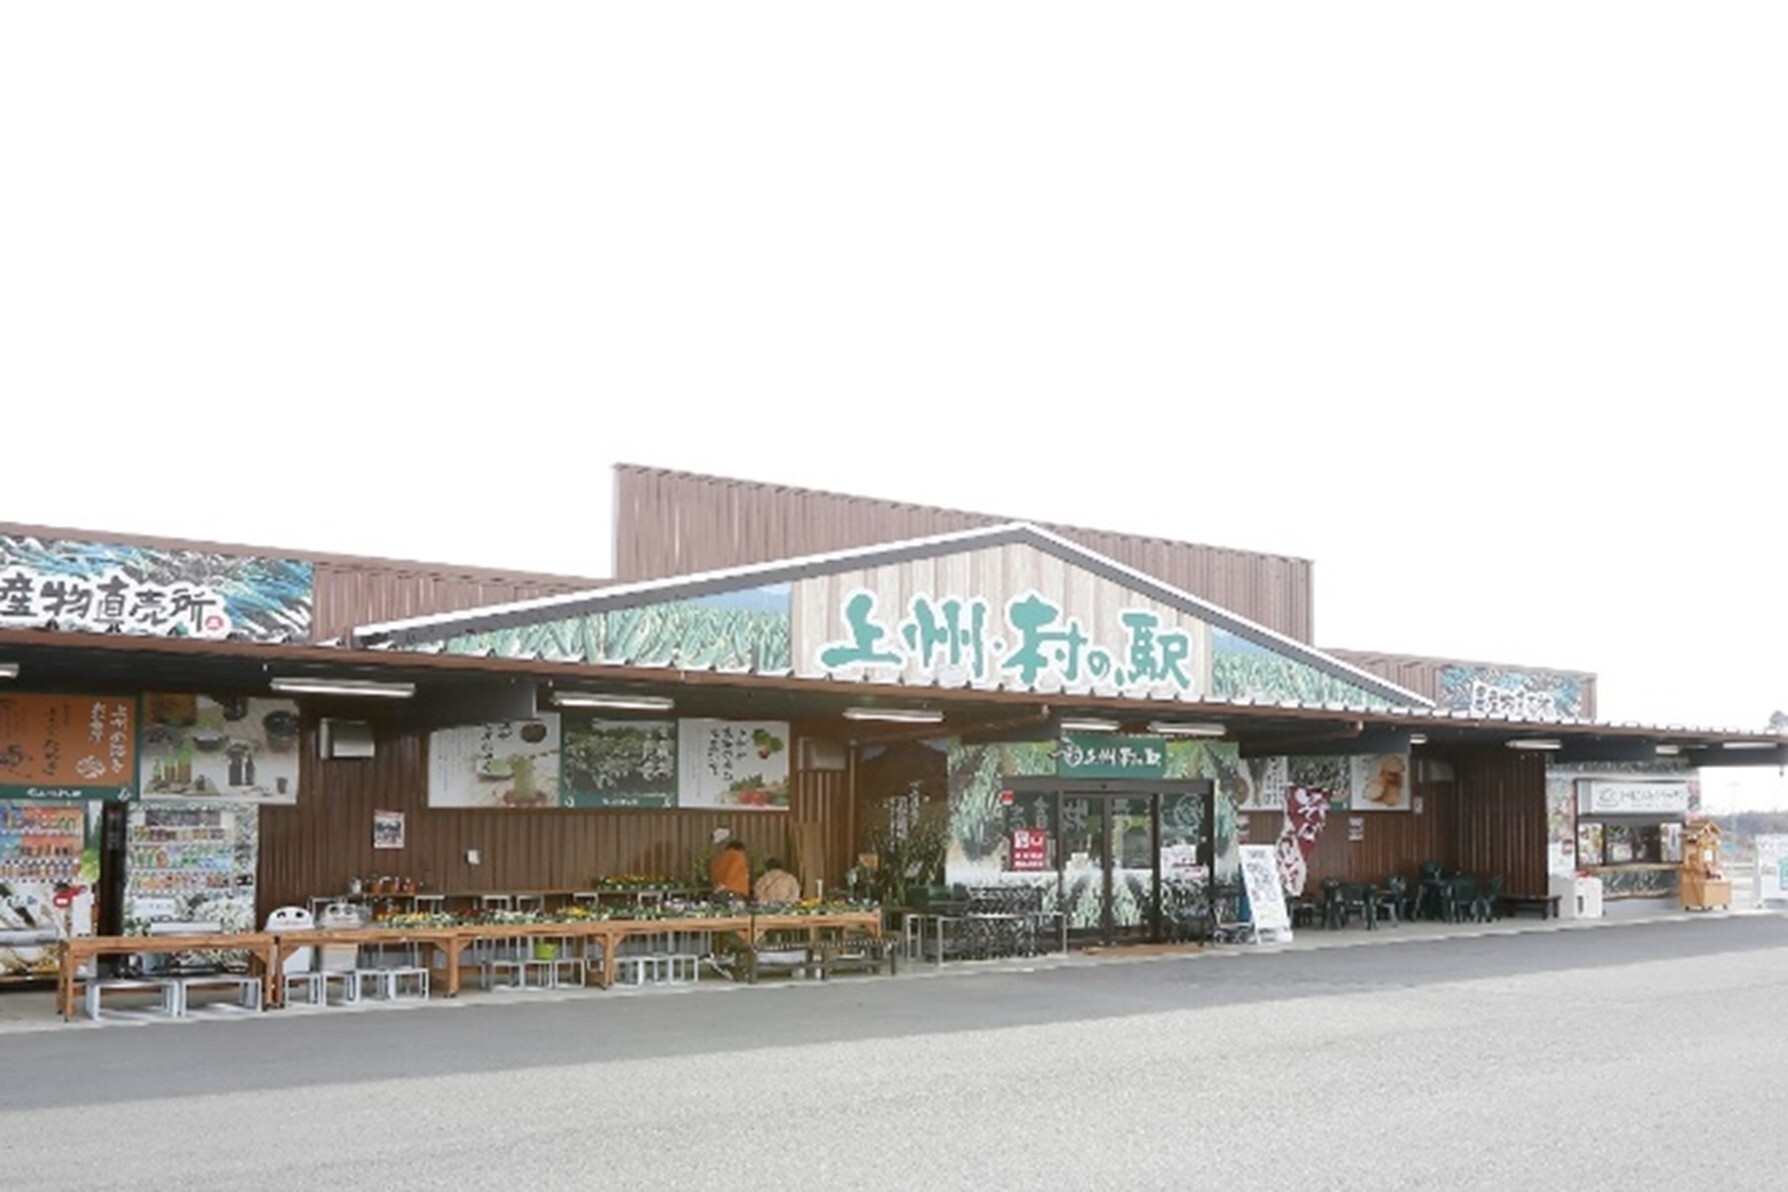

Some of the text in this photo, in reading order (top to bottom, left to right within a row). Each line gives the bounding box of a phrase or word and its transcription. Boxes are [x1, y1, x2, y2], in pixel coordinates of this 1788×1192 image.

[0, 572, 216, 632] 産物直売所
[820, 593, 1191, 690] 上州・村の駅
